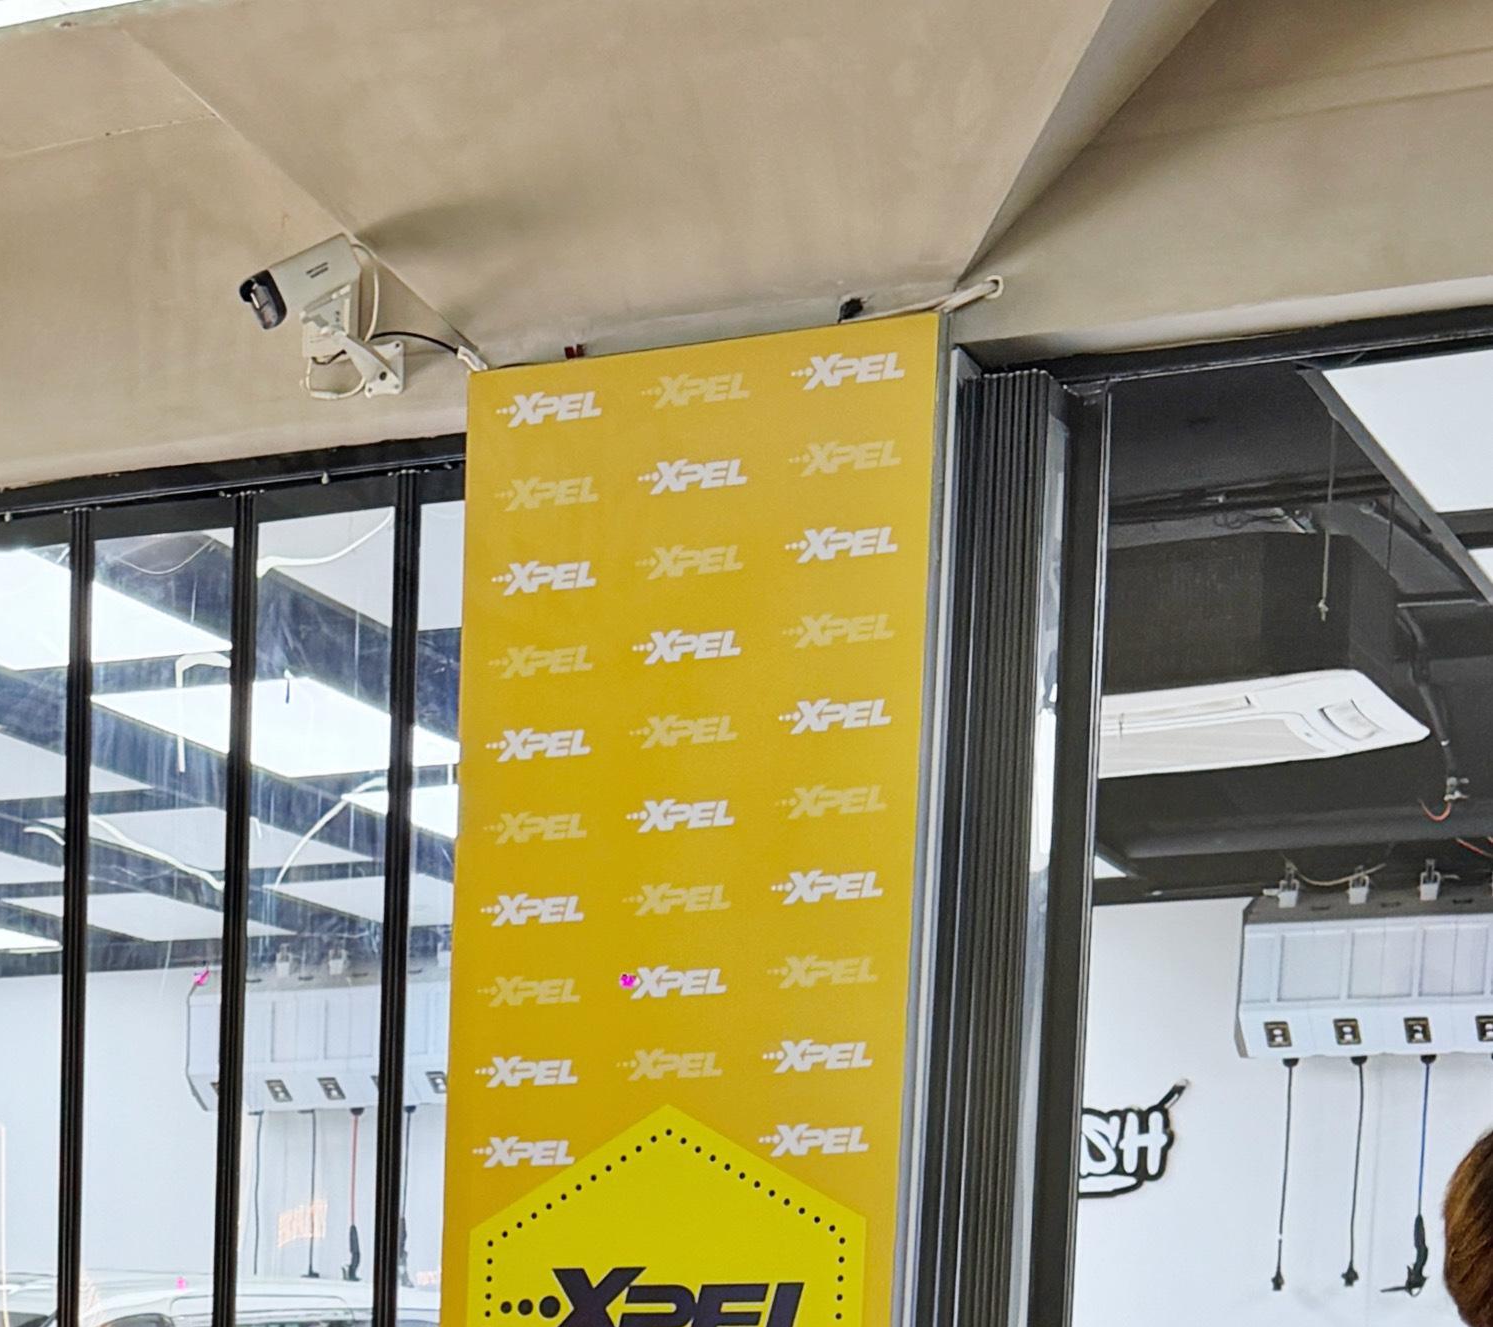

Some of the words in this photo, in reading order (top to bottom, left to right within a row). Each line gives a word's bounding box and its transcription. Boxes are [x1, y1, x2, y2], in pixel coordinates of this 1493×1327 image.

[801, 352, 905, 391] XPEL
[654, 374, 749, 407] XPEL
[506, 390, 602, 428] XPEL
[801, 441, 900, 475] XPEL
[504, 476, 598, 511] XPEL
[647, 457, 749, 496] XPEL
[794, 525, 899, 564] XPEL
[500, 559, 597, 597] XPEL
[646, 545, 742, 580] XPEL
[641, 628, 743, 666] XPEL
[793, 613, 893, 648] XPEL
[500, 645, 594, 678] XPEL
[639, 714, 738, 749] XPEL
[787, 697, 892, 735] XPEL
[495, 726, 593, 763] XPEL
[634, 797, 737, 834] XPEL
[787, 784, 886, 819] XPEL
[495, 812, 588, 844] XPEL
[633, 883, 731, 916] XPEL
[780, 867, 884, 906] XPEL
[488, 891, 586, 928] XPEL
[630, 963, 728, 1001] XPEL
[777, 954, 877, 989] XPEL
[488, 976, 581, 1007] XPEL
[484, 1054, 580, 1089] XPEL
[626, 1048, 723, 1081] XPEL
[771, 1037, 874, 1074] XPEL
[480, 1135, 576, 1169] XPEL
[767, 1122, 870, 1159] XPEL
